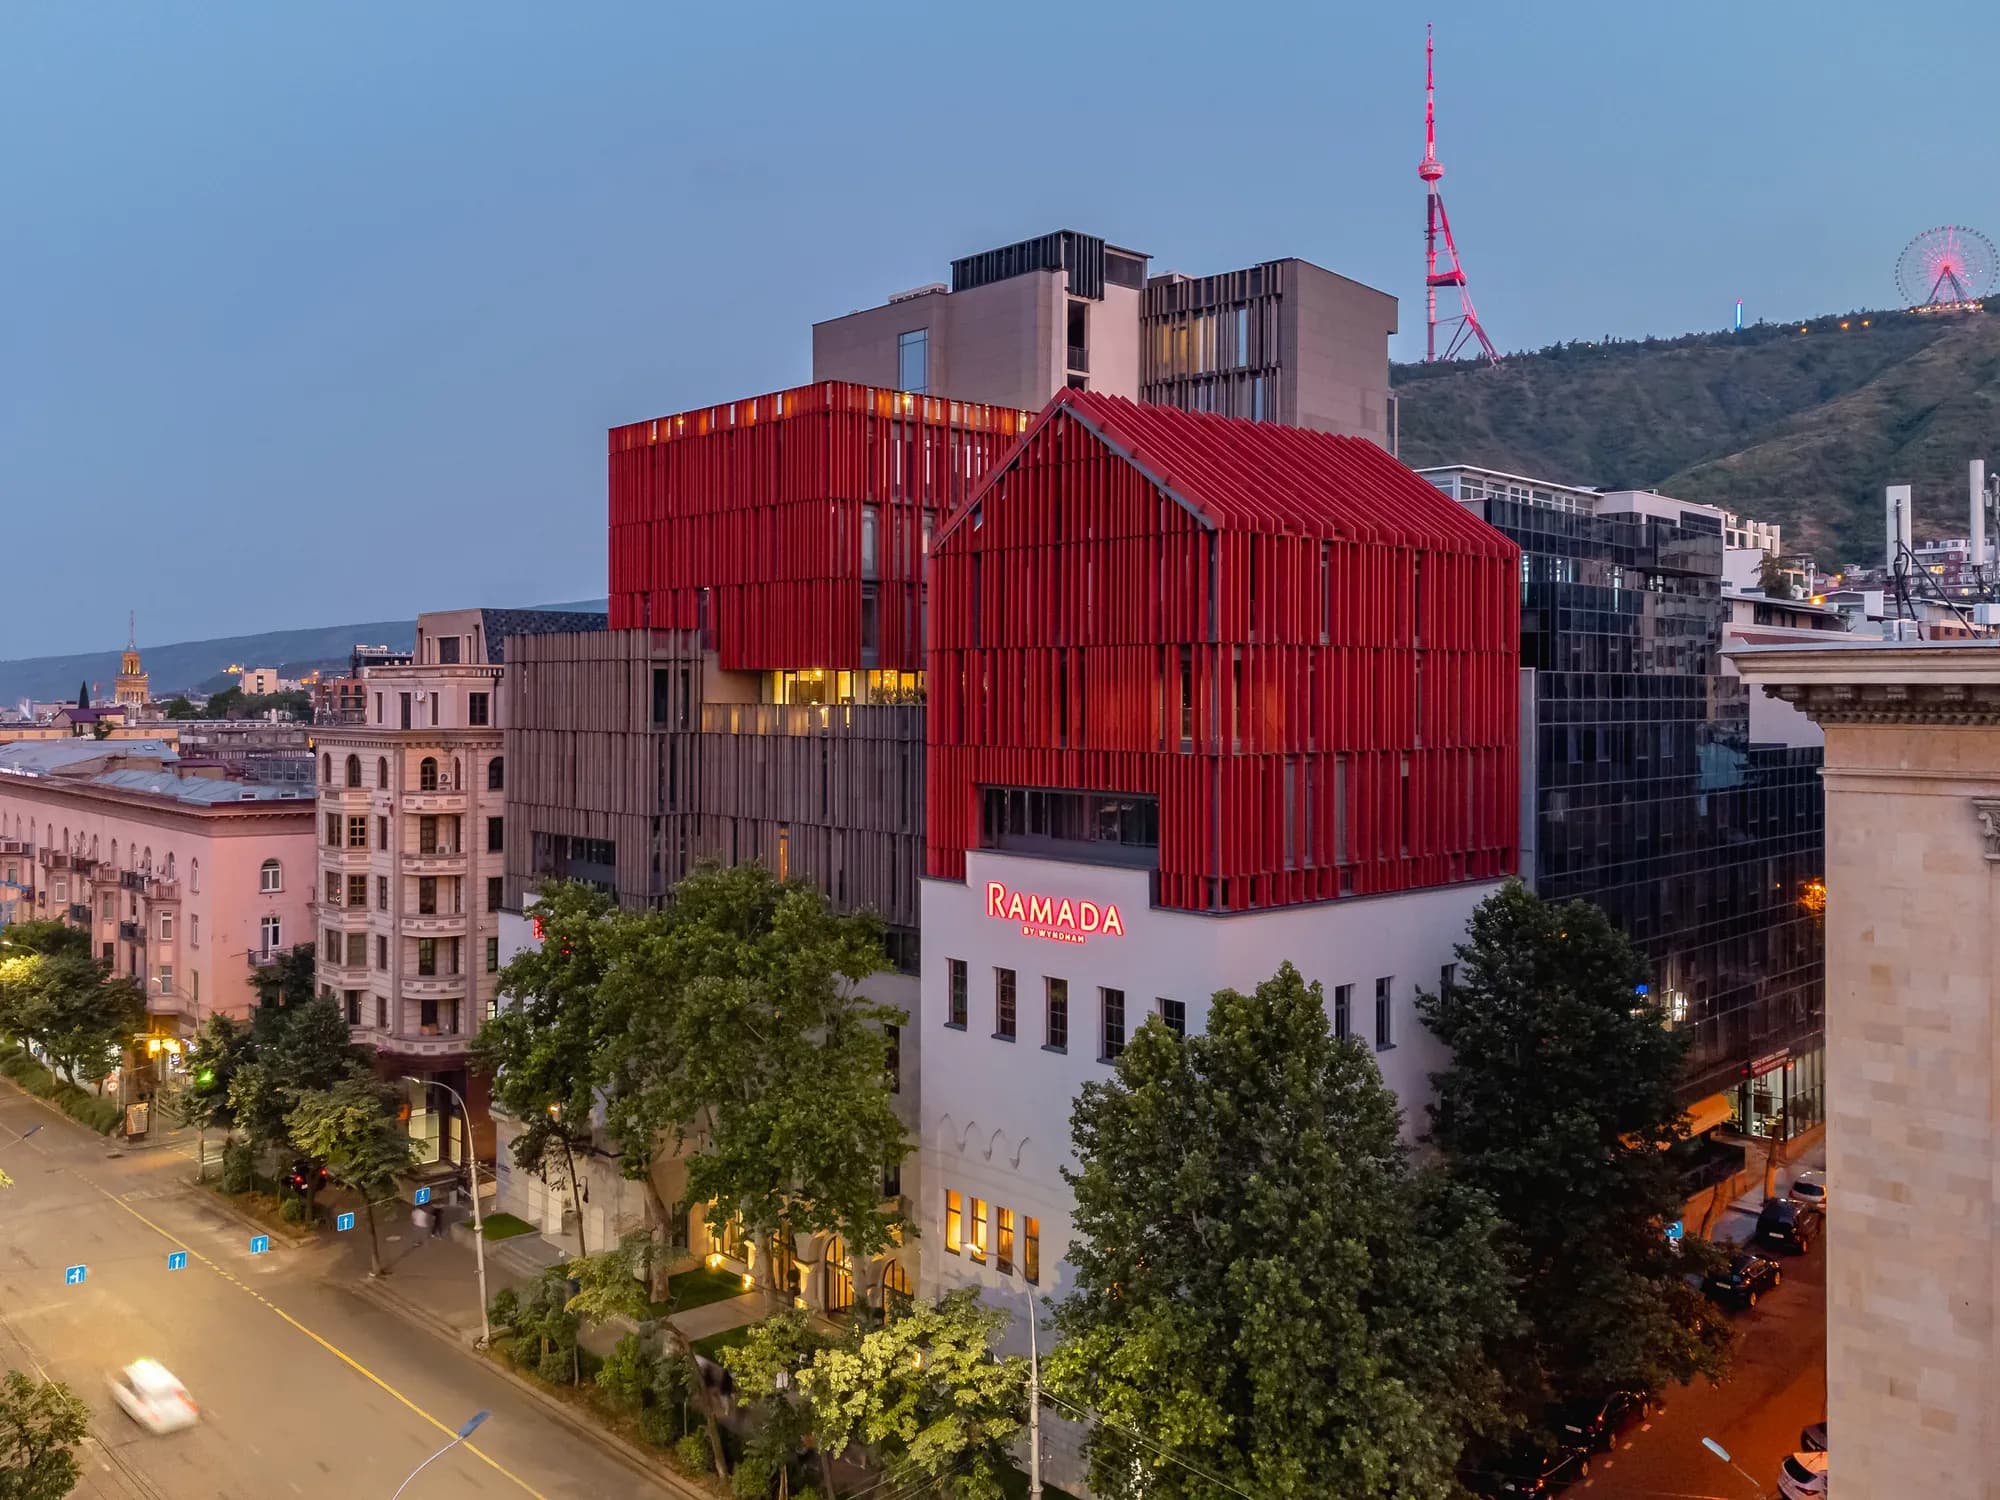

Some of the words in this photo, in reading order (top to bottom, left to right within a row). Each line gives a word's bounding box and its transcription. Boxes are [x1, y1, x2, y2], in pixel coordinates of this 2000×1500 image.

[987, 881, 1124, 936] RAMADA
[1023, 926, 1035, 936] BY
[1038, 929, 1085, 943] WYNDHAM
